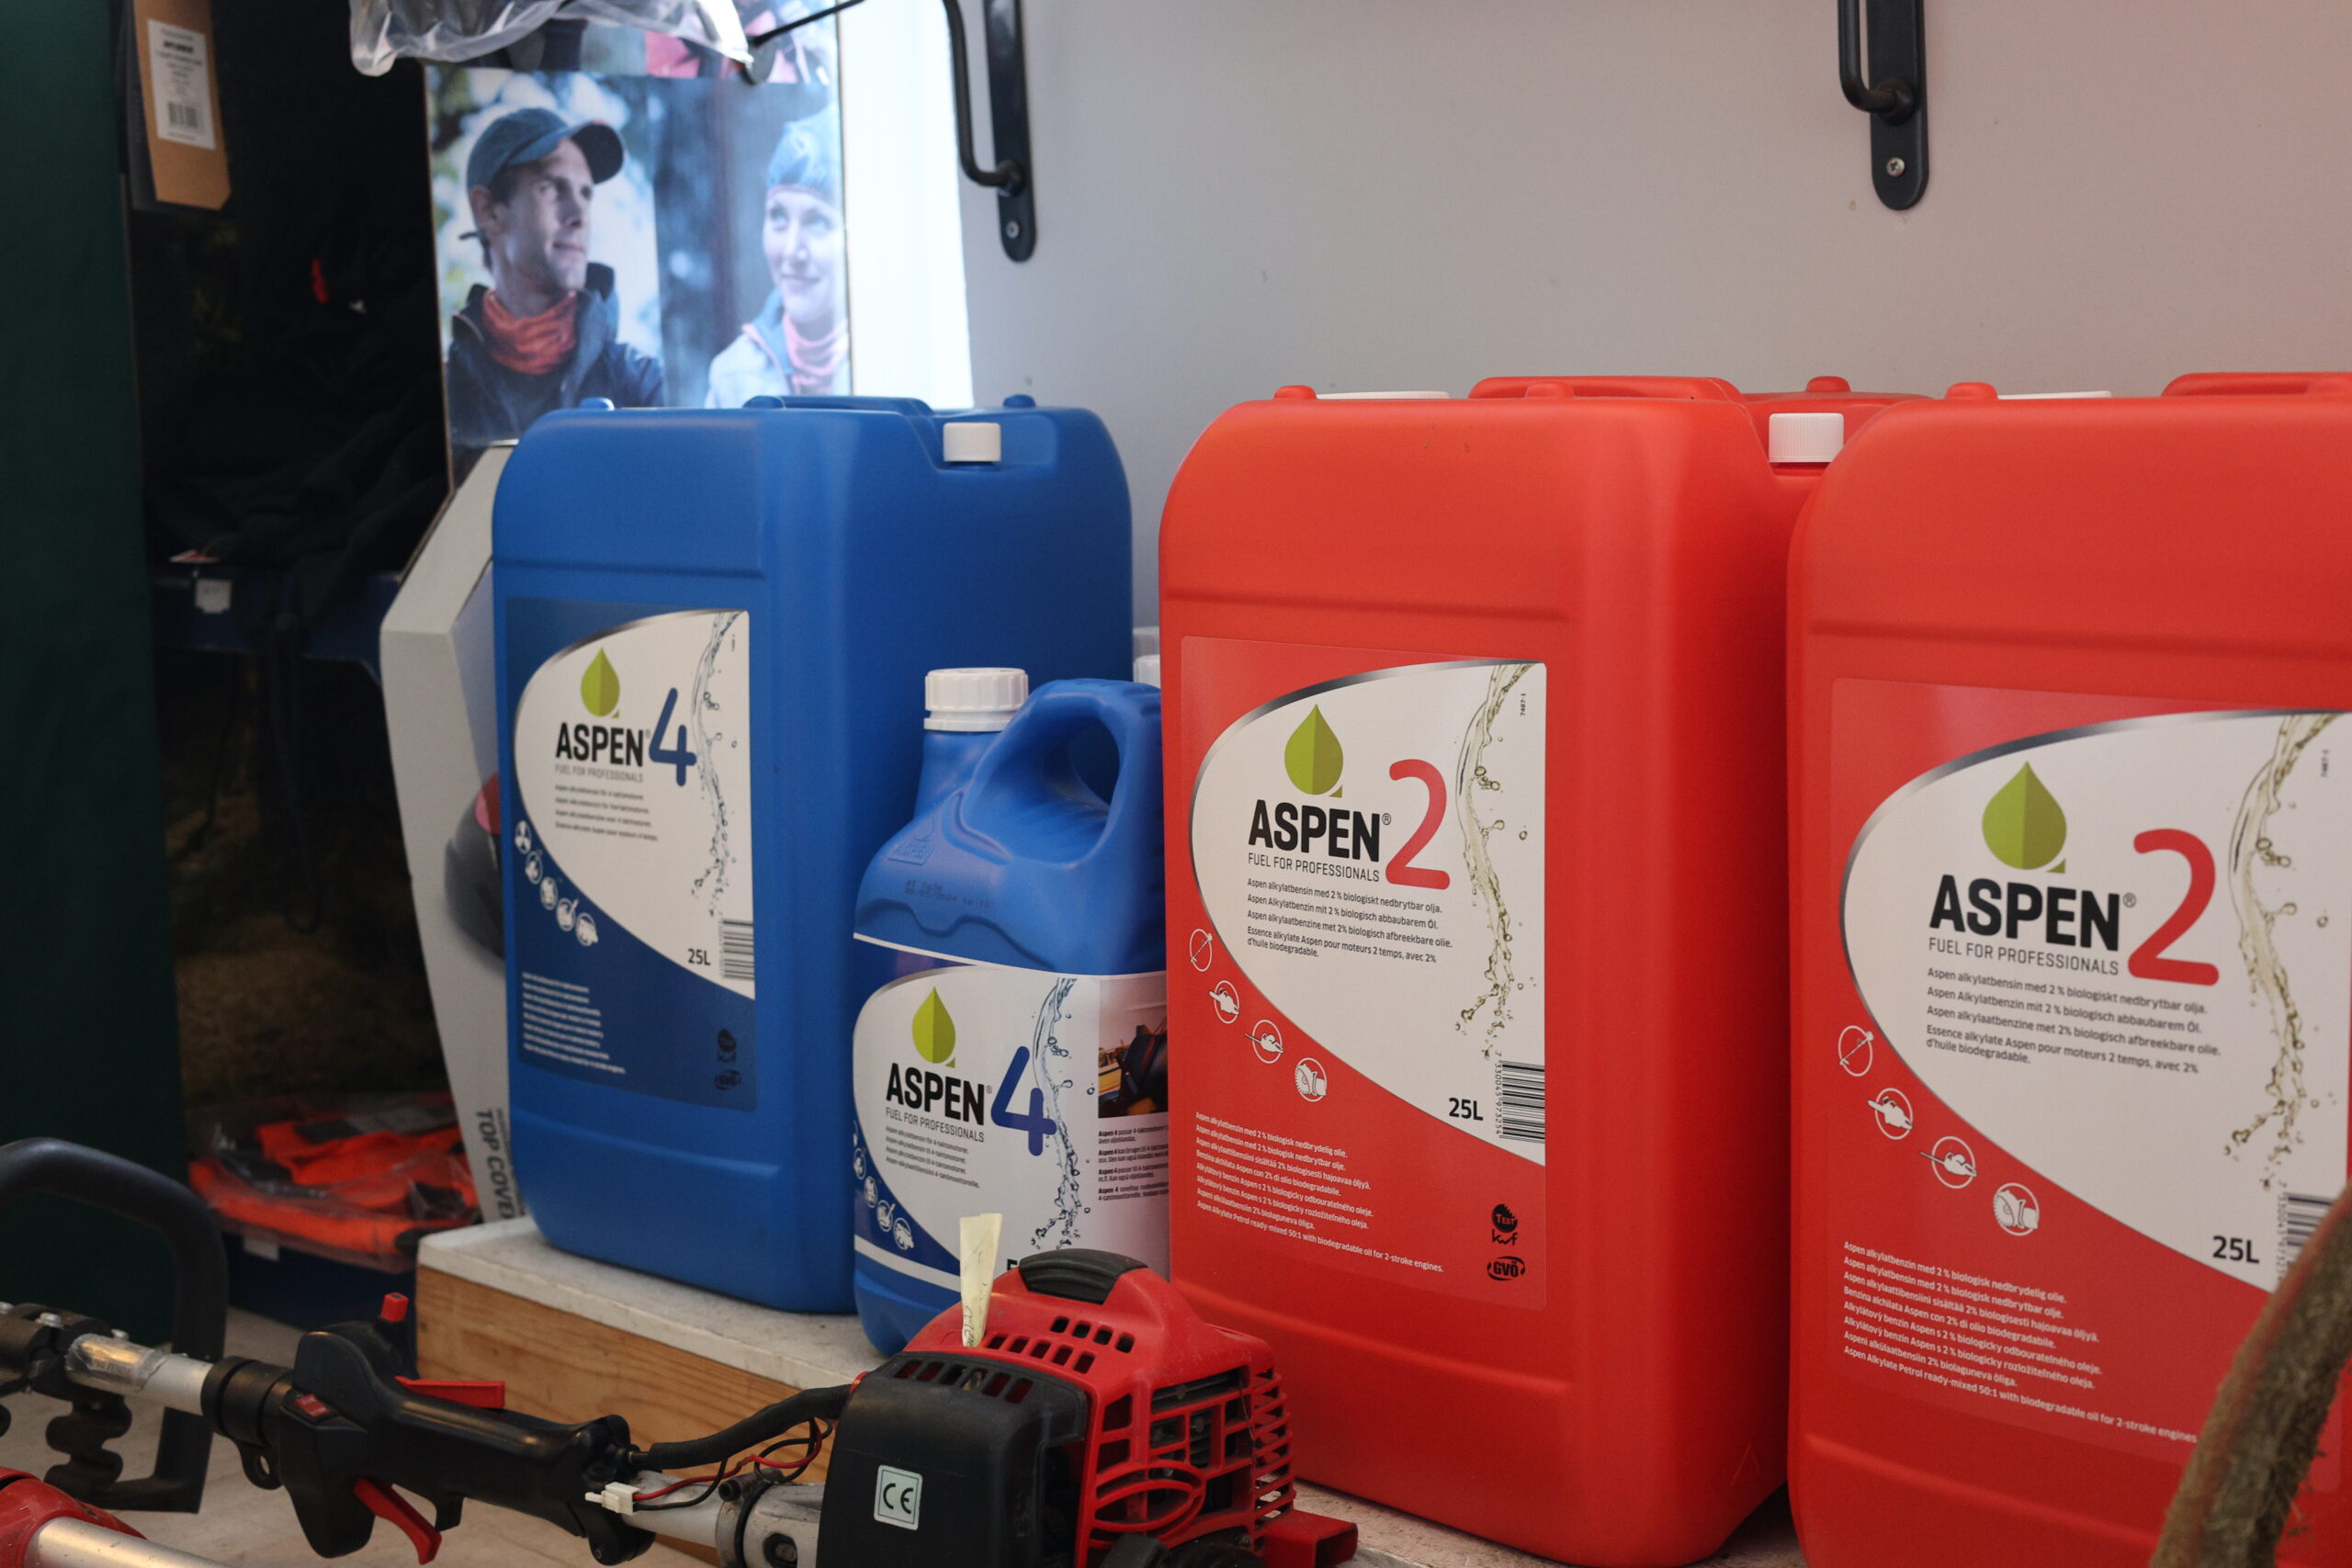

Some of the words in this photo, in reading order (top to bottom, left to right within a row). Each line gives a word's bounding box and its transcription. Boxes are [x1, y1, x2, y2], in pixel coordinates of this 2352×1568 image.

[649, 687, 697, 786] 4
[1385, 759, 1450, 890] 2
[1248, 852, 1271, 867] FUEL
[1273, 855, 1293, 870] FOR
[1295, 859, 1379, 883] PROFESSIONALS
[1247, 877, 1267, 888] Aspen
[1268, 881, 1313, 896] alkylatbensin
[1314, 888, 1329, 898] med
[1330, 889, 1336, 899] 2
[1343, 891, 1379, 905] biologiskt
[1380, 897, 1423, 910] nedbrytbar
[1425, 903, 1442, 914] olja.
[1247, 893, 1267, 905] Aspen
[1268, 897, 1314, 912] Alkylatbenzin
[1315, 905, 1327, 914] mit
[1328, 906, 1333, 915] 2
[1340, 908, 1376, 921] biologisch
[1378, 913, 1426, 928] abbaubarem
[1428, 919, 1438, 930] Öl.
[2127, 829, 2220, 987] 2
[1247, 908, 1267, 920] Aspen
[1268, 913, 1321, 930] alkylaatbenzine
[1322, 922, 1336, 932] met
[1337, 923, 1347, 933] 2%
[1348, 925, 1385, 939] biologisch
[1385, 931, 1433, 946] afbreekbare
[1435, 937, 1452, 948] olie.
[1247, 925, 1272, 938] Essence
[1272, 931, 1300, 943] alkylate
[1301, 934, 1322, 946] Aspen
[1324, 939, 1340, 949] pour
[1341, 942, 1371, 954] moteurs
[1373, 945, 1377, 955] 2
[1378, 947, 1404, 959] temps,
[1405, 951, 1423, 962] avec
[1425, 953, 1436, 964] 2%
[687, 948, 711, 966] 25L
[1269, 941, 1318, 957] biodegradable.
[1928, 936, 1962, 955] FUEL
[1965, 942, 1993, 959] FOR
[1997, 945, 2119, 976] PROFESSIONALS
[1927, 966, 1955, 980] Aspen
[1958, 972, 2022, 990] alkylatbensin
[2024, 982, 2046, 993] med
[2049, 984, 2055, 995] 2
[2066, 986, 2118, 1003] biologiskt
[2120, 995, 2181, 1010] nedbrytbar
[2183, 1001, 2207, 1015] olja.
[1927, 986, 1955, 999] Aspen
[1957, 990, 2024, 1010] Alkylatbenzin
[2026, 1001, 2042, 1012] mit
[2044, 1002, 2052, 1014] 2
[2063, 1005, 2114, 1022] biologisch
[2116, 1013, 2184, 1031] abbaubarem
[2187, 1020, 2202, 1033] Öl.
[1927, 1004, 1955, 1019] Aspen
[1957, 1010, 2033, 1031] alkylaatbenzine
[2035, 1022, 2055, 1033] met
[2057, 1023, 2071, 1036] 2%
[2074, 1026, 2125, 1043] biologisch
[2128, 1034, 2195, 1053] afbreekbare
[2197, 1043, 2221, 1056] olie.
[1927, 1023, 1962, 1040] Essence
[1964, 1031, 2003, 1046] alkylate
[2005, 1036, 2036, 1050] Aspen
[2038, 1043, 2061, 1055] pour
[2064, 1046, 2106, 1062] moteurs
[2109, 1051, 2115, 1063] 2
[2117, 1053, 2153, 1068] temps,
[2154, 1059, 2179, 1072] avec
[2183, 1061, 2198, 1074] 2%
[1958, 1043, 2030, 1064] biodegradable.
[990, 1045, 1057, 1156] 4
[1449, 1097, 1484, 1121] 25L
[476, 1108, 499, 1151] TOP
[886, 1107, 902, 1122] FUEL
[904, 1112, 918, 1125] FOR
[920, 1116, 985, 1143] PROFESSIONALS
[2212, 1235, 2260, 1264] 25L
[1843, 1240, 1865, 1255] Aspen
[1866, 1248, 1916, 1269] alkylatbenzin
[1917, 1263, 1934, 1275] med
[1936, 1266, 1942, 1277] 2
[1951, 1269, 1990, 1287] biologisk
[1991, 1280, 2046, 1301] nedbrydelig
[1843, 1284, 1871, 1303] Benzina
[1871, 1295, 1902, 1313] alchilata
[1904, 1304, 1928, 1319] Aspen
[1929, 1312, 1945, 1323] con
[1946, 1314, 1958, 1326] 2%
[1959, 1318, 1968, 1328] di
[1969, 1321, 1985, 1333] olio
[1844, 1345, 1866, 1359] Aspen
[1867, 1352, 1897, 1371] Alkylate
[1898, 1362, 1923, 1378] Petrol
[1924, 1371, 1976, 1393] ready-mixed
[1978, 1384, 1997, 1397] 50:1
[1998, 1391, 2018, 1403] with
[2020, 1393, 2085, 1418] biodegradable
[2086, 1411, 2098, 1422] oil
[2099, 1412, 2113, 1425] for
[2116, 1416, 2156, 1435] 2-stroke
